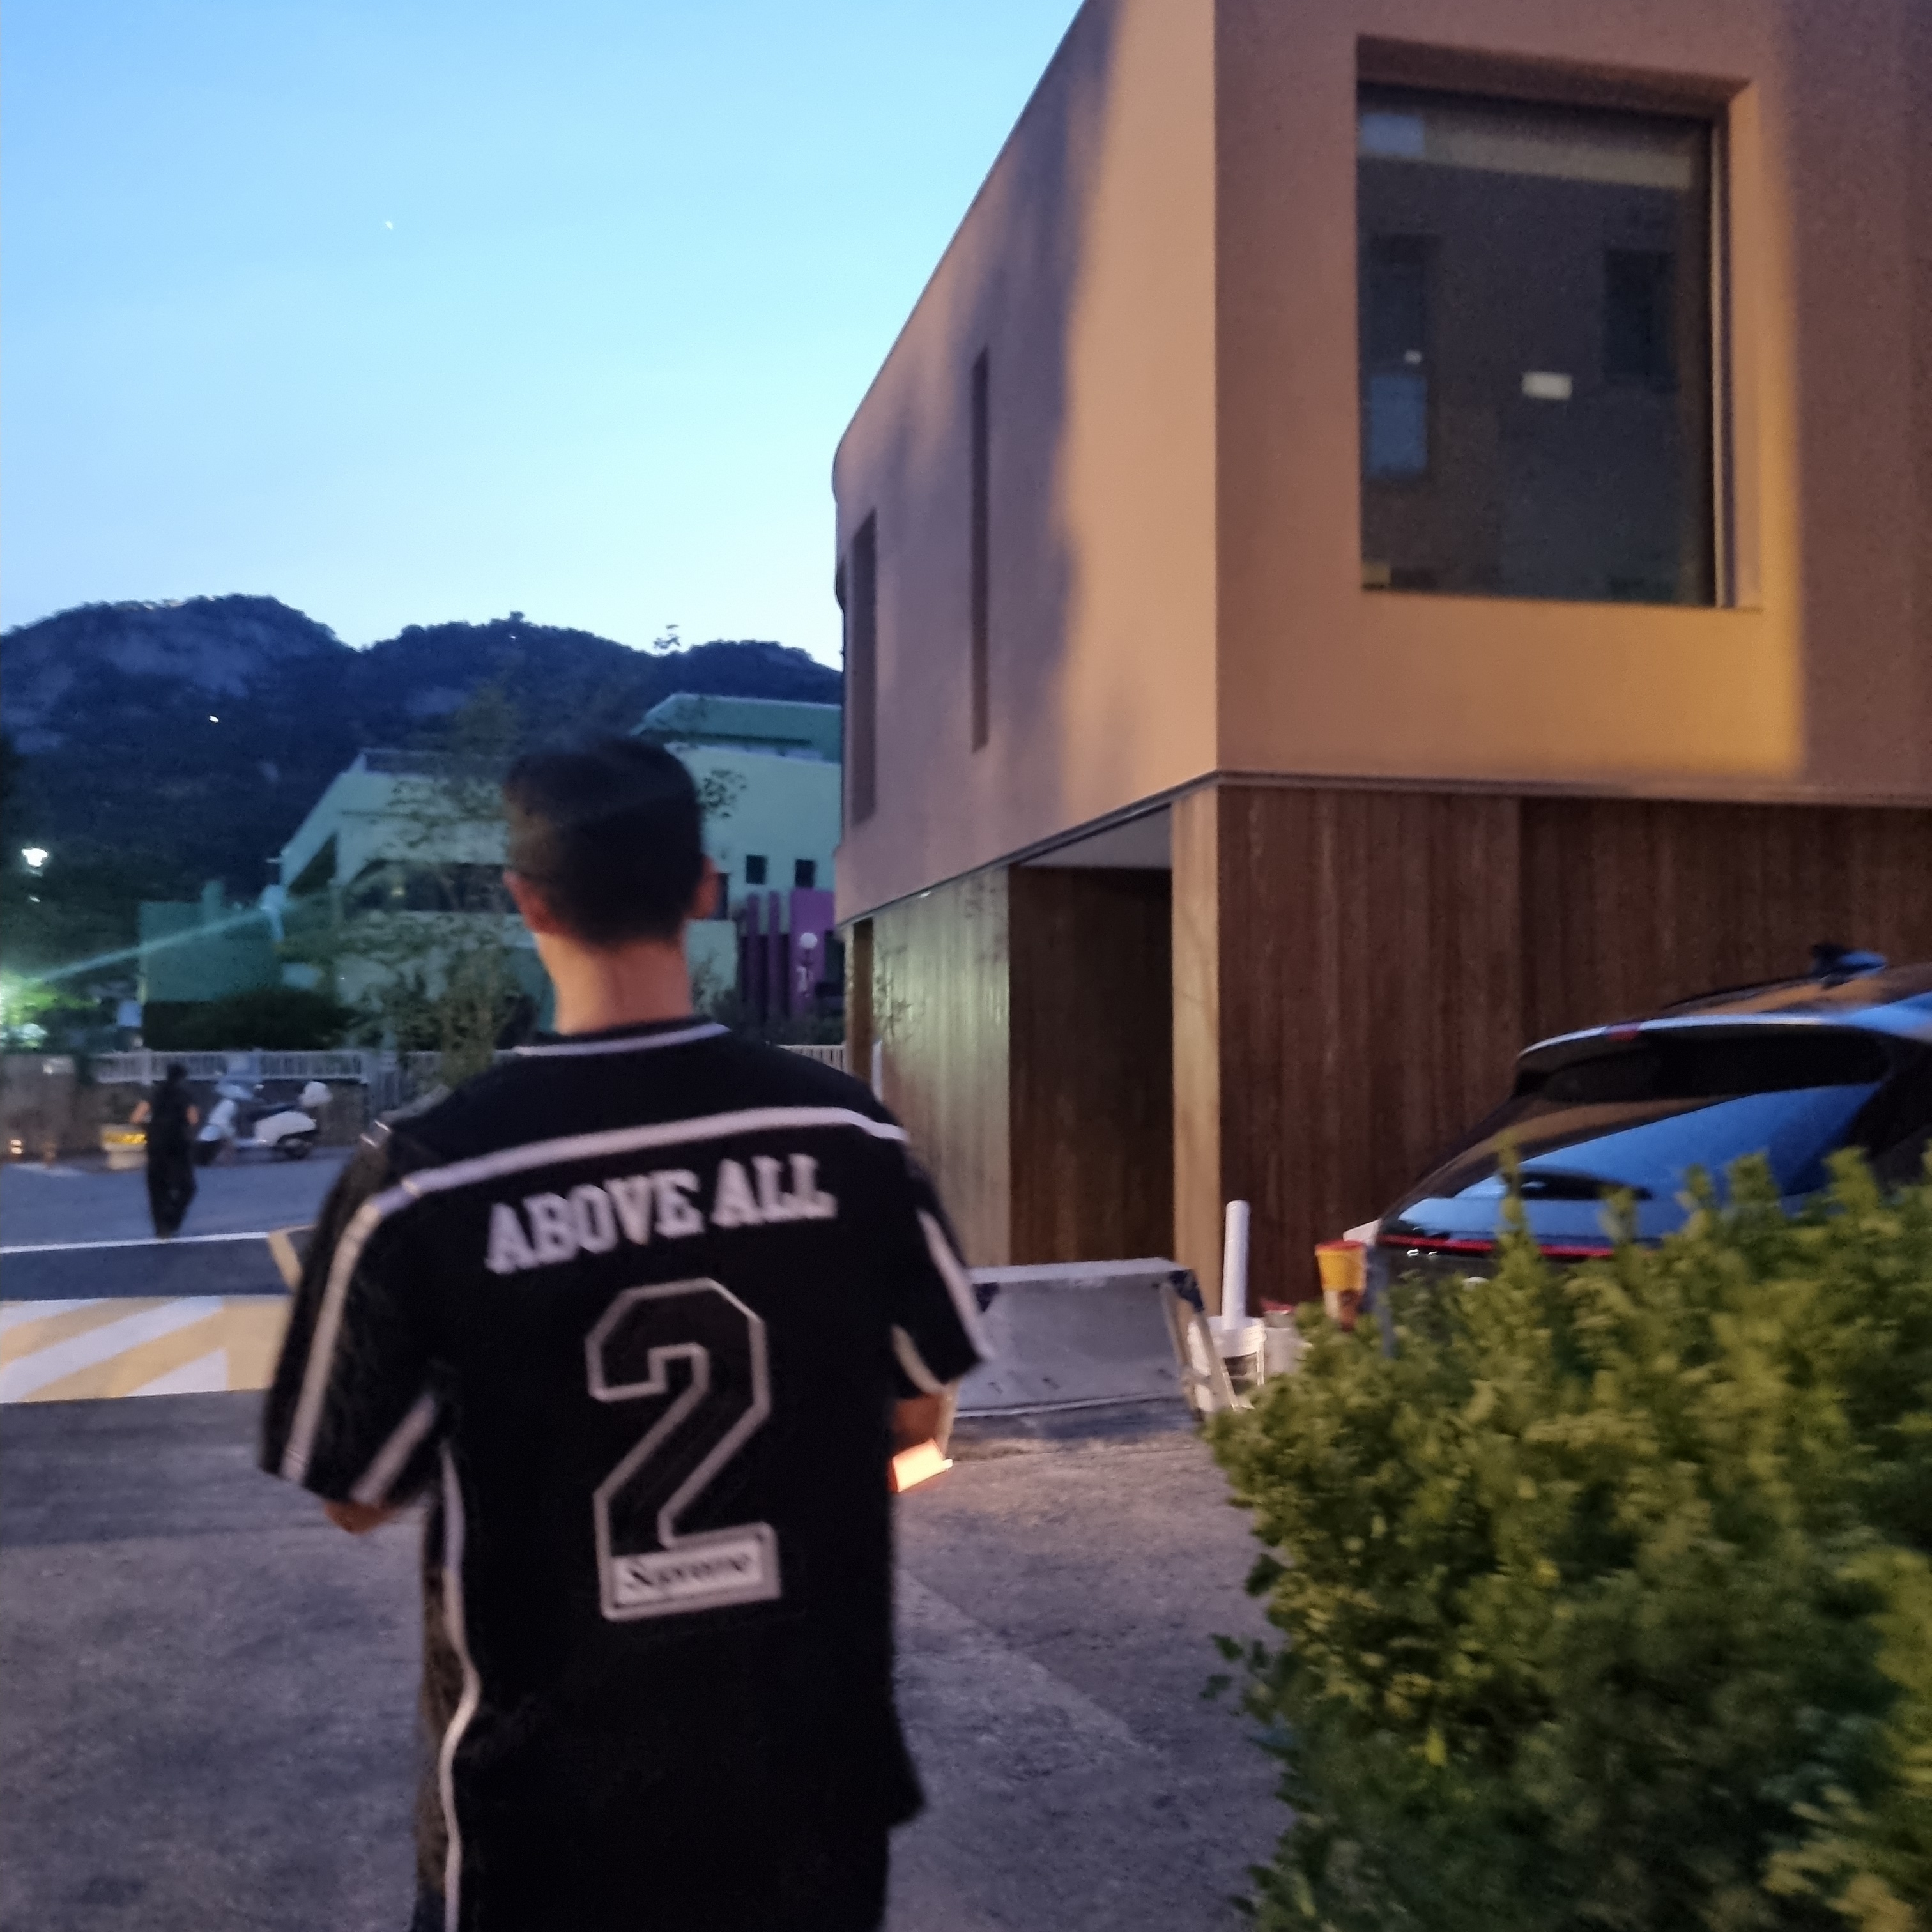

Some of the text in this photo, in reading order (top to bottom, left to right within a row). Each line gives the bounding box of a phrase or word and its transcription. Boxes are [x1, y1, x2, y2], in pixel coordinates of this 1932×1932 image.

[486, 1154, 837, 1274] ABOVE ALL
[586, 1278, 781, 1621] 2
